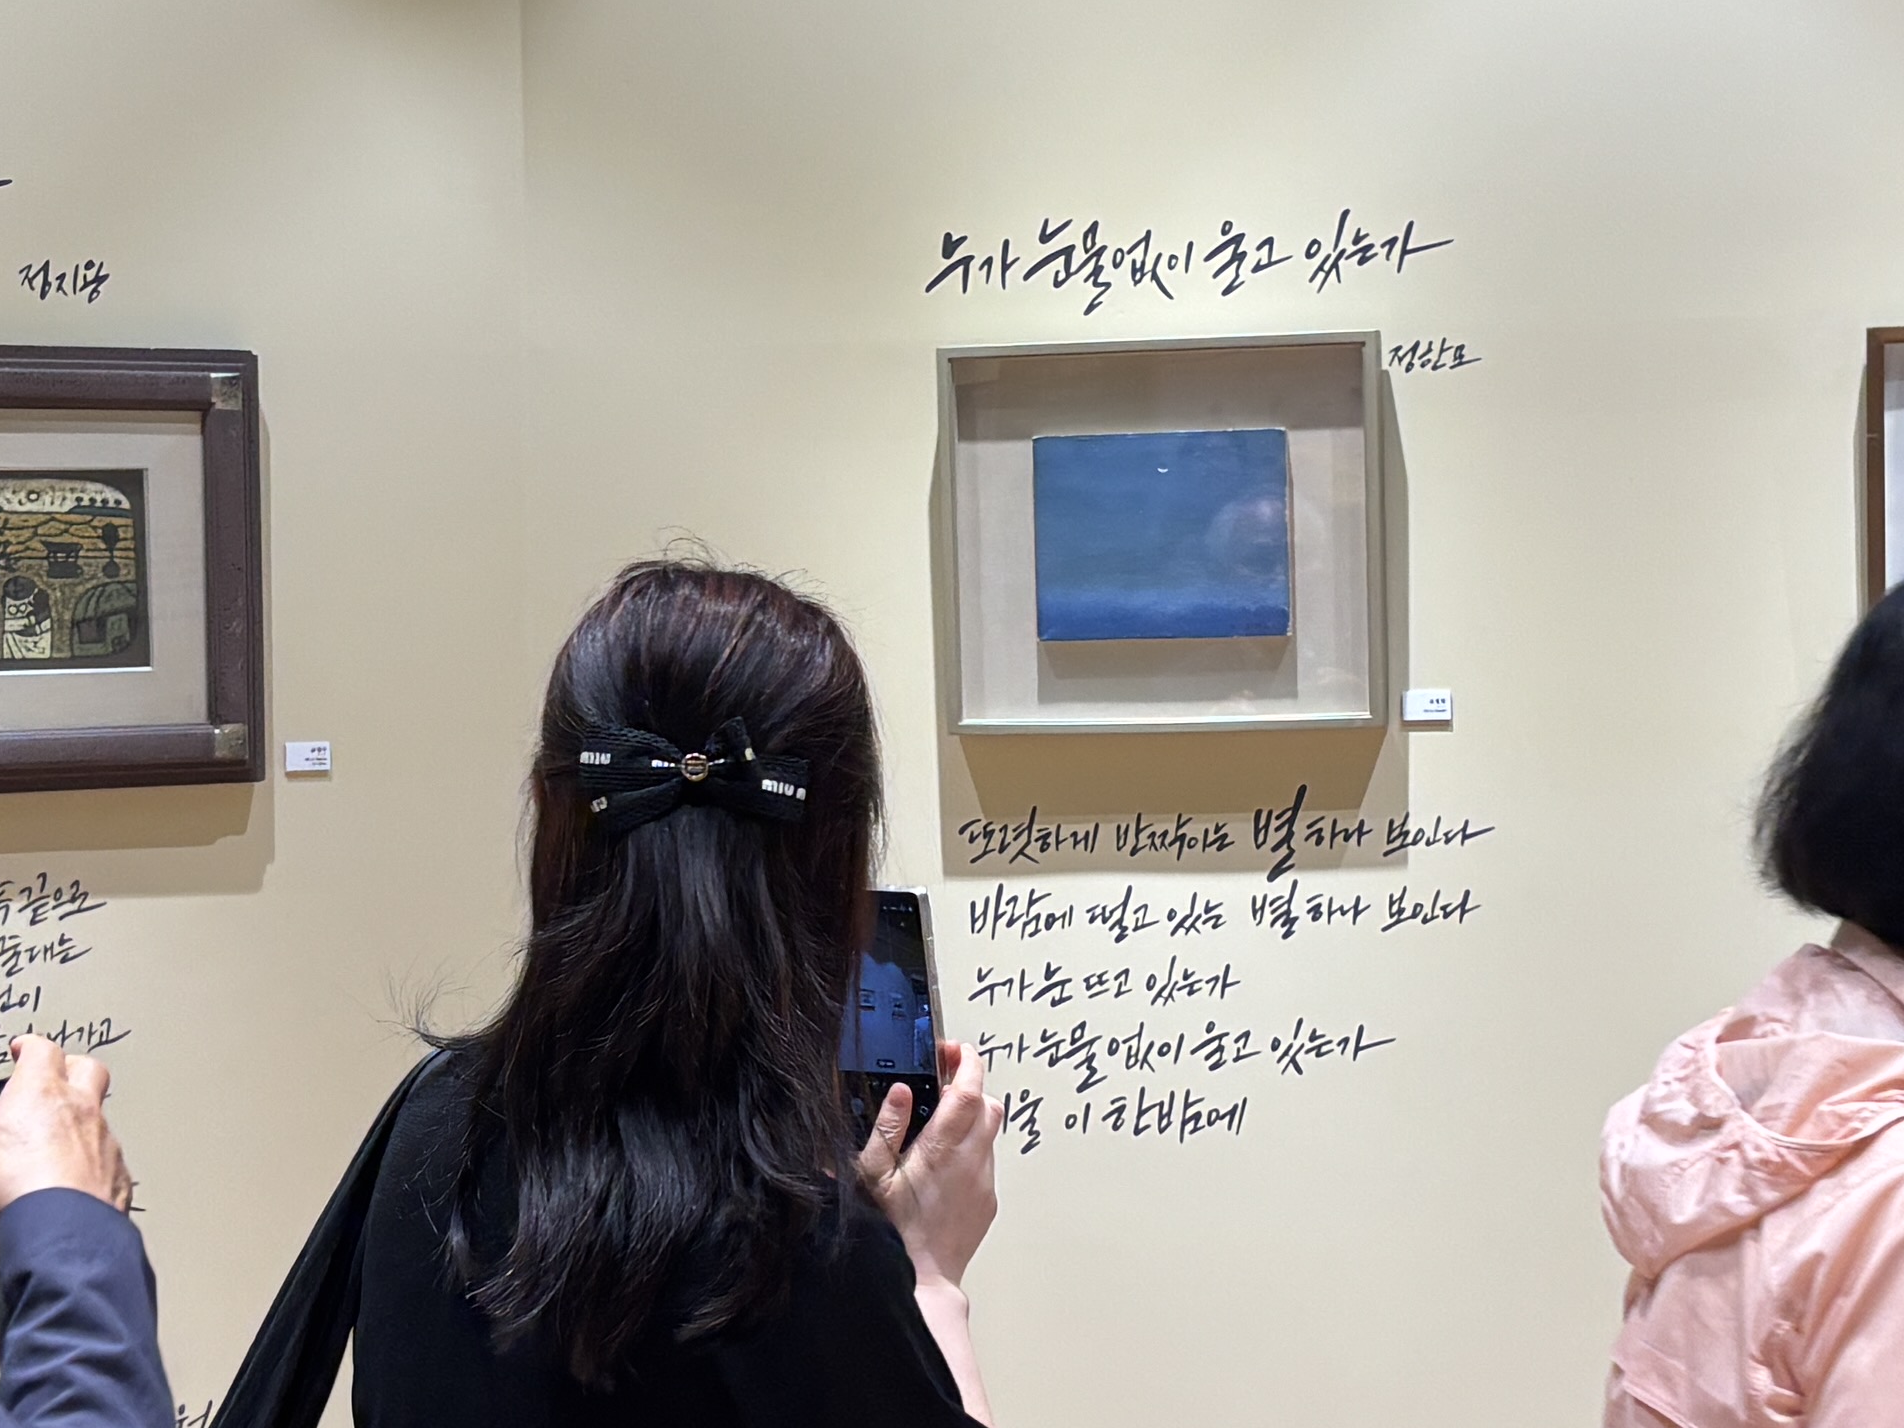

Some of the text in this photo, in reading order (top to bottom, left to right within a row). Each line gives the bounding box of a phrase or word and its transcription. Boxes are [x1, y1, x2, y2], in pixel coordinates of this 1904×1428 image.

[925, 232, 1021, 294] 누가
[1203, 220, 1294, 297] 울고
[1305, 209, 1455, 294] 있는가
[958, 783, 1496, 884] 또렷하게 반짝이는 별 하나 보인다
[18, 872, 107, 927] 끝으로
[969, 878, 1482, 945] 바람에 떨고 있는 별 하나 보인다
[968, 967, 1035, 1008] 누가
[1083, 968, 1133, 1000] 뜨고
[1145, 955, 1242, 1008] 있는가
[977, 1031, 1031, 1074] 누가
[1189, 1021, 1263, 1072] 울고
[1271, 1018, 1397, 1076] 있는가
[1065, 1102, 1092, 1135] 이
